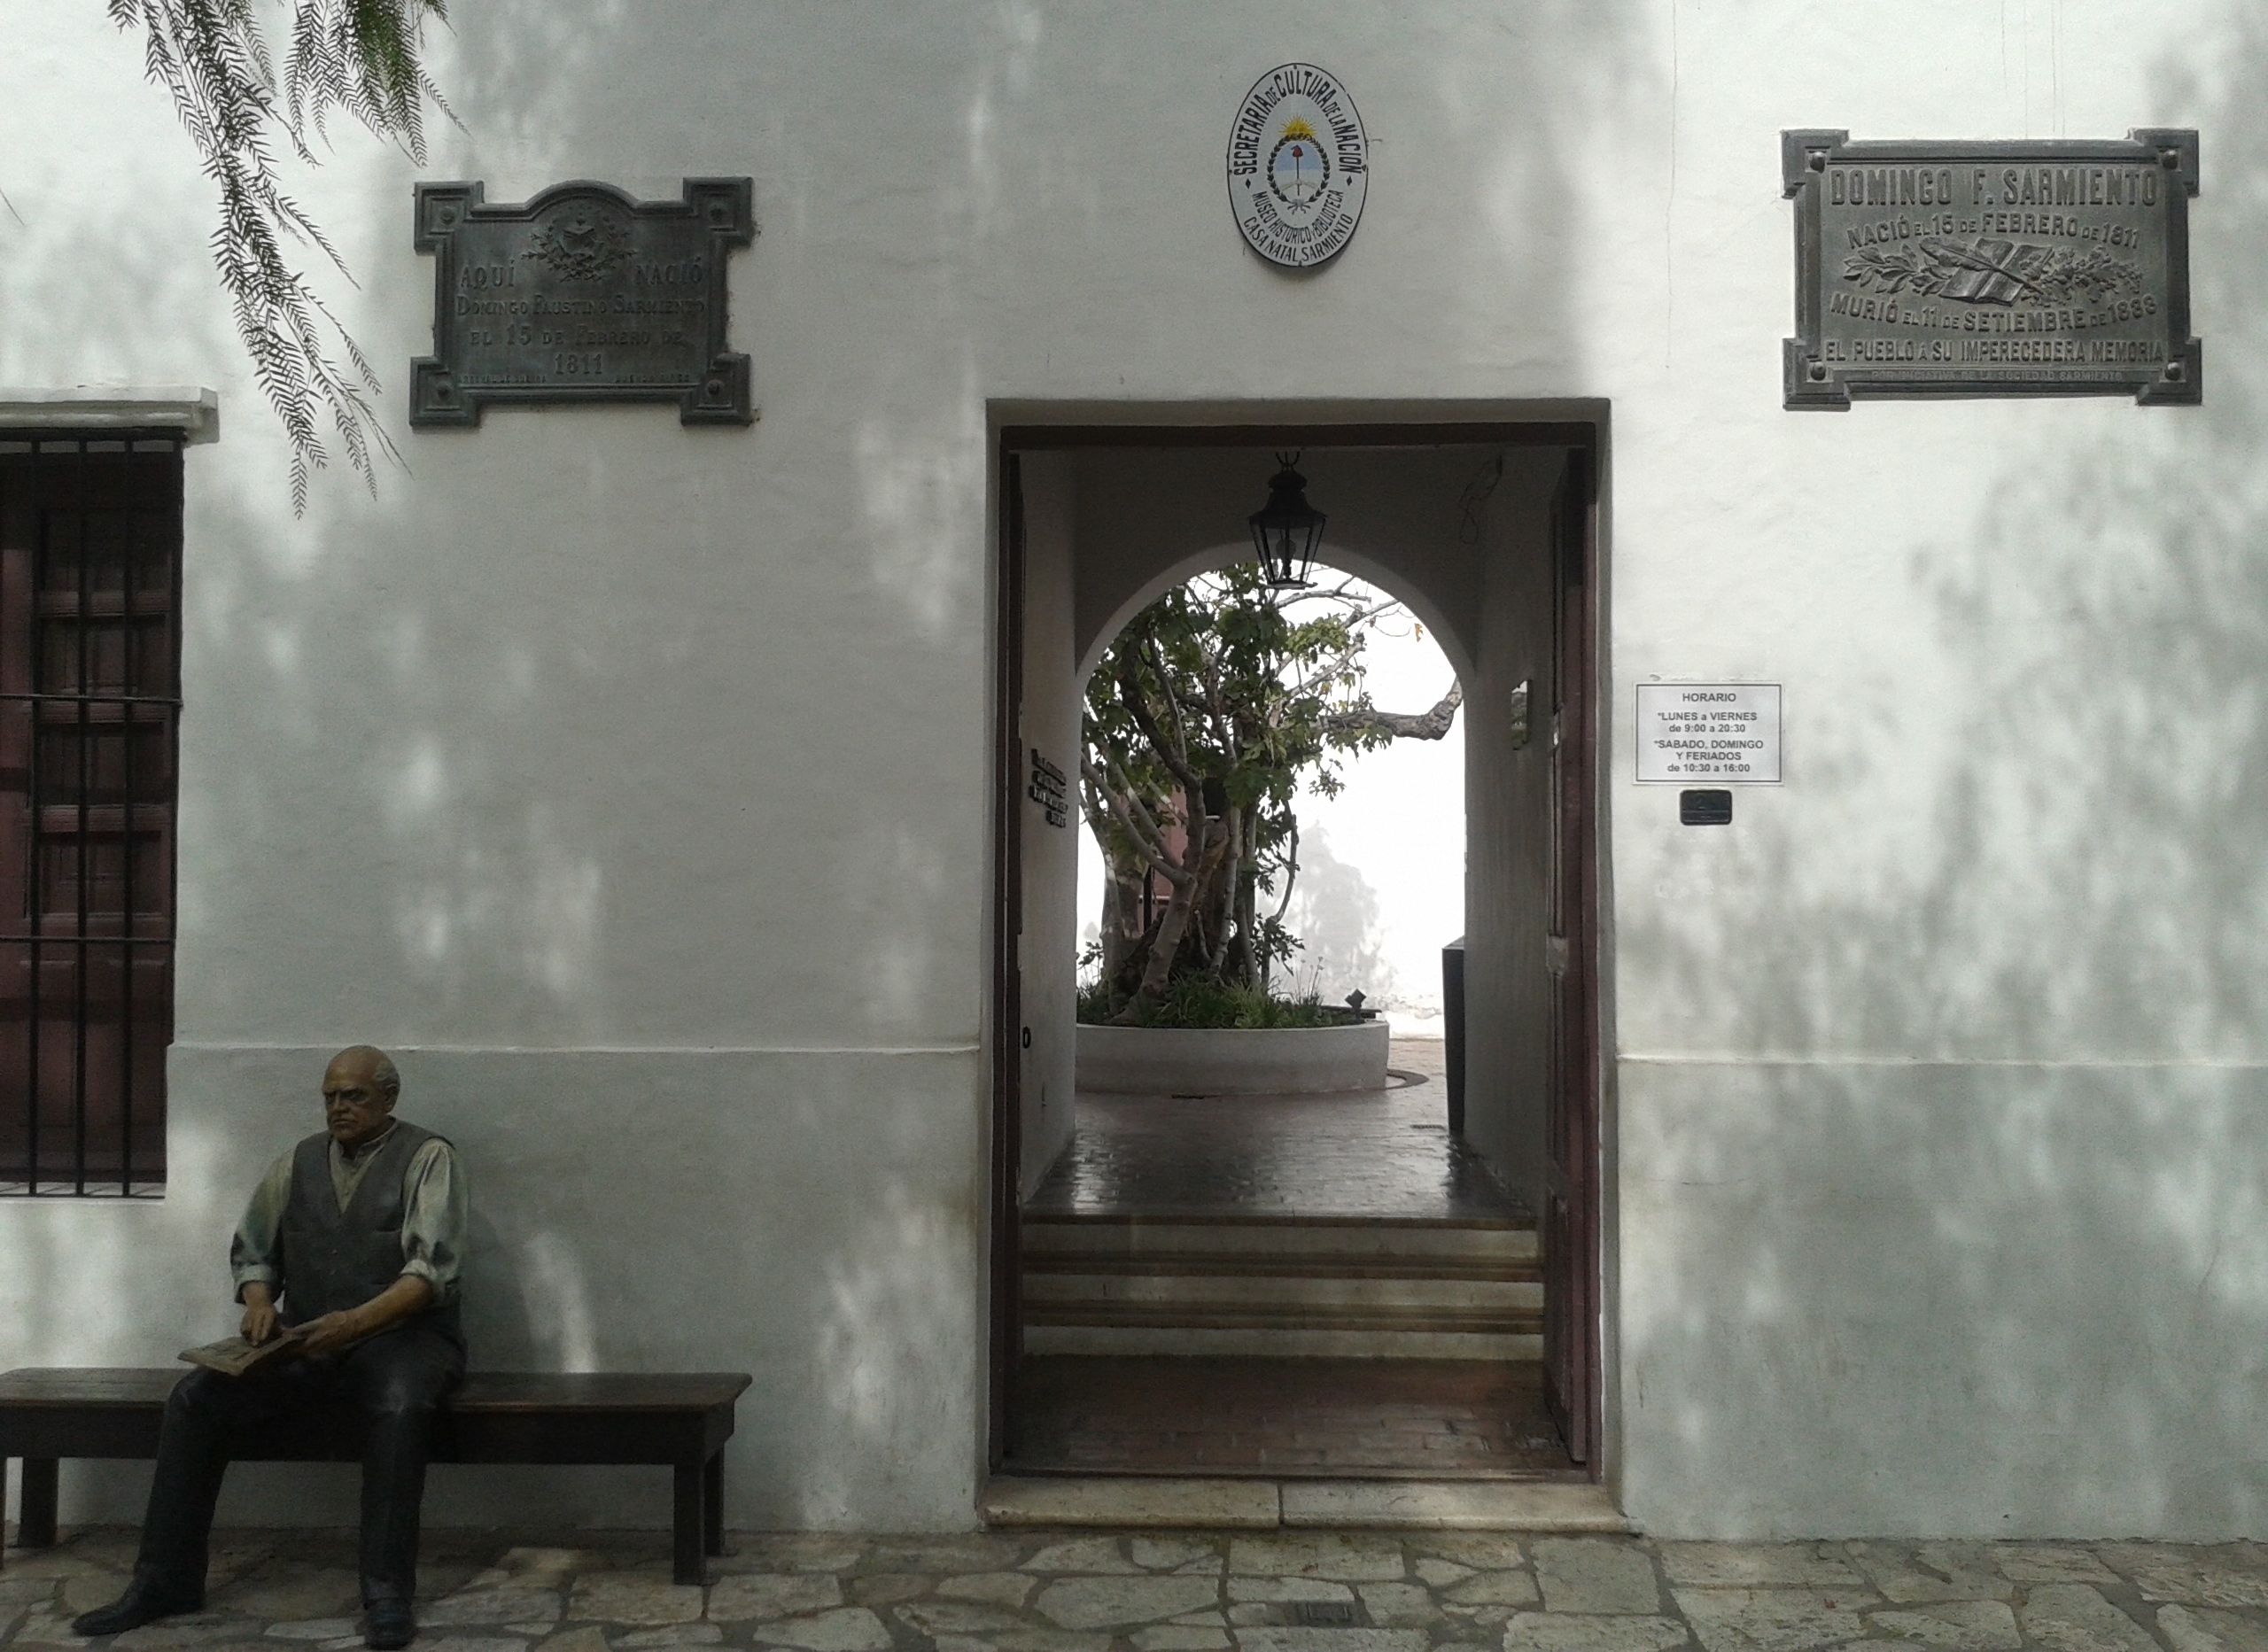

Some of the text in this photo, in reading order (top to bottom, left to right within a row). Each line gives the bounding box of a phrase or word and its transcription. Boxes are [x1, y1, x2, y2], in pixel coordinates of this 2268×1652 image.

[1266, 86, 1280, 105] DE
[1273, 70, 1337, 109] CULTURA
[1323, 101, 1341, 117] DE
[1328, 114, 1347, 130] LA
[1233, 94, 1272, 175] SECRETARIA
[1830, 168, 2156, 206] DOMINGO F. SARMIENTO
[1252, 190, 1278, 224] MUSEO
[1268, 216, 1311, 244] HISTORICO
[1312, 190, 1344, 237] BIBLIOTECA
[1243, 213, 1354, 262] CASA NATAL SARMIENTO
[1846, 212, 2139, 250] NACIÓ EL 15 DE FEBRERO DE 1811
[460, 256, 703, 291] AQUÍ NACIÓ
[456, 293, 706, 316] DOMINGO FAUSTINO SARMIENTO
[1830, 292, 2158, 333] MURIÓ EL 11 DE SETIEMBRE DE 1888
[470, 324, 682, 345] EL 15 DE FEBRERO DE
[1824, 340, 1846, 361] EL
[1853, 340, 1915, 361] PUEBLO
[1931, 340, 1953, 361] SU
[1961, 340, 2085, 362] IMPERECEDERA
[2091, 340, 2164, 362] MEMORIA
[555, 353, 602, 375] 1811
[1871, 370, 1894, 381] POR
[1961, 370, 1977, 381] DE
[1997, 370, 2055, 381] SOCIEDAD
[2059, 370, 2123, 381] SARMIENTO
[1682, 693, 1736, 702] HORARIO
[1710, 712, 1758, 721] VIERNES
[1668, 724, 1682, 733] de
[1684, 724, 1706, 733] 9:00
[1718, 724, 1745, 733] 20:30
[1711, 740, 1764, 749] DOMINGO
[1676, 751, 1742, 761] Y FERIADOS
[1667, 764, 1680, 772] de
[1684, 764, 1711, 772] 10:30
[1723, 764, 1751, 772] 16:00
